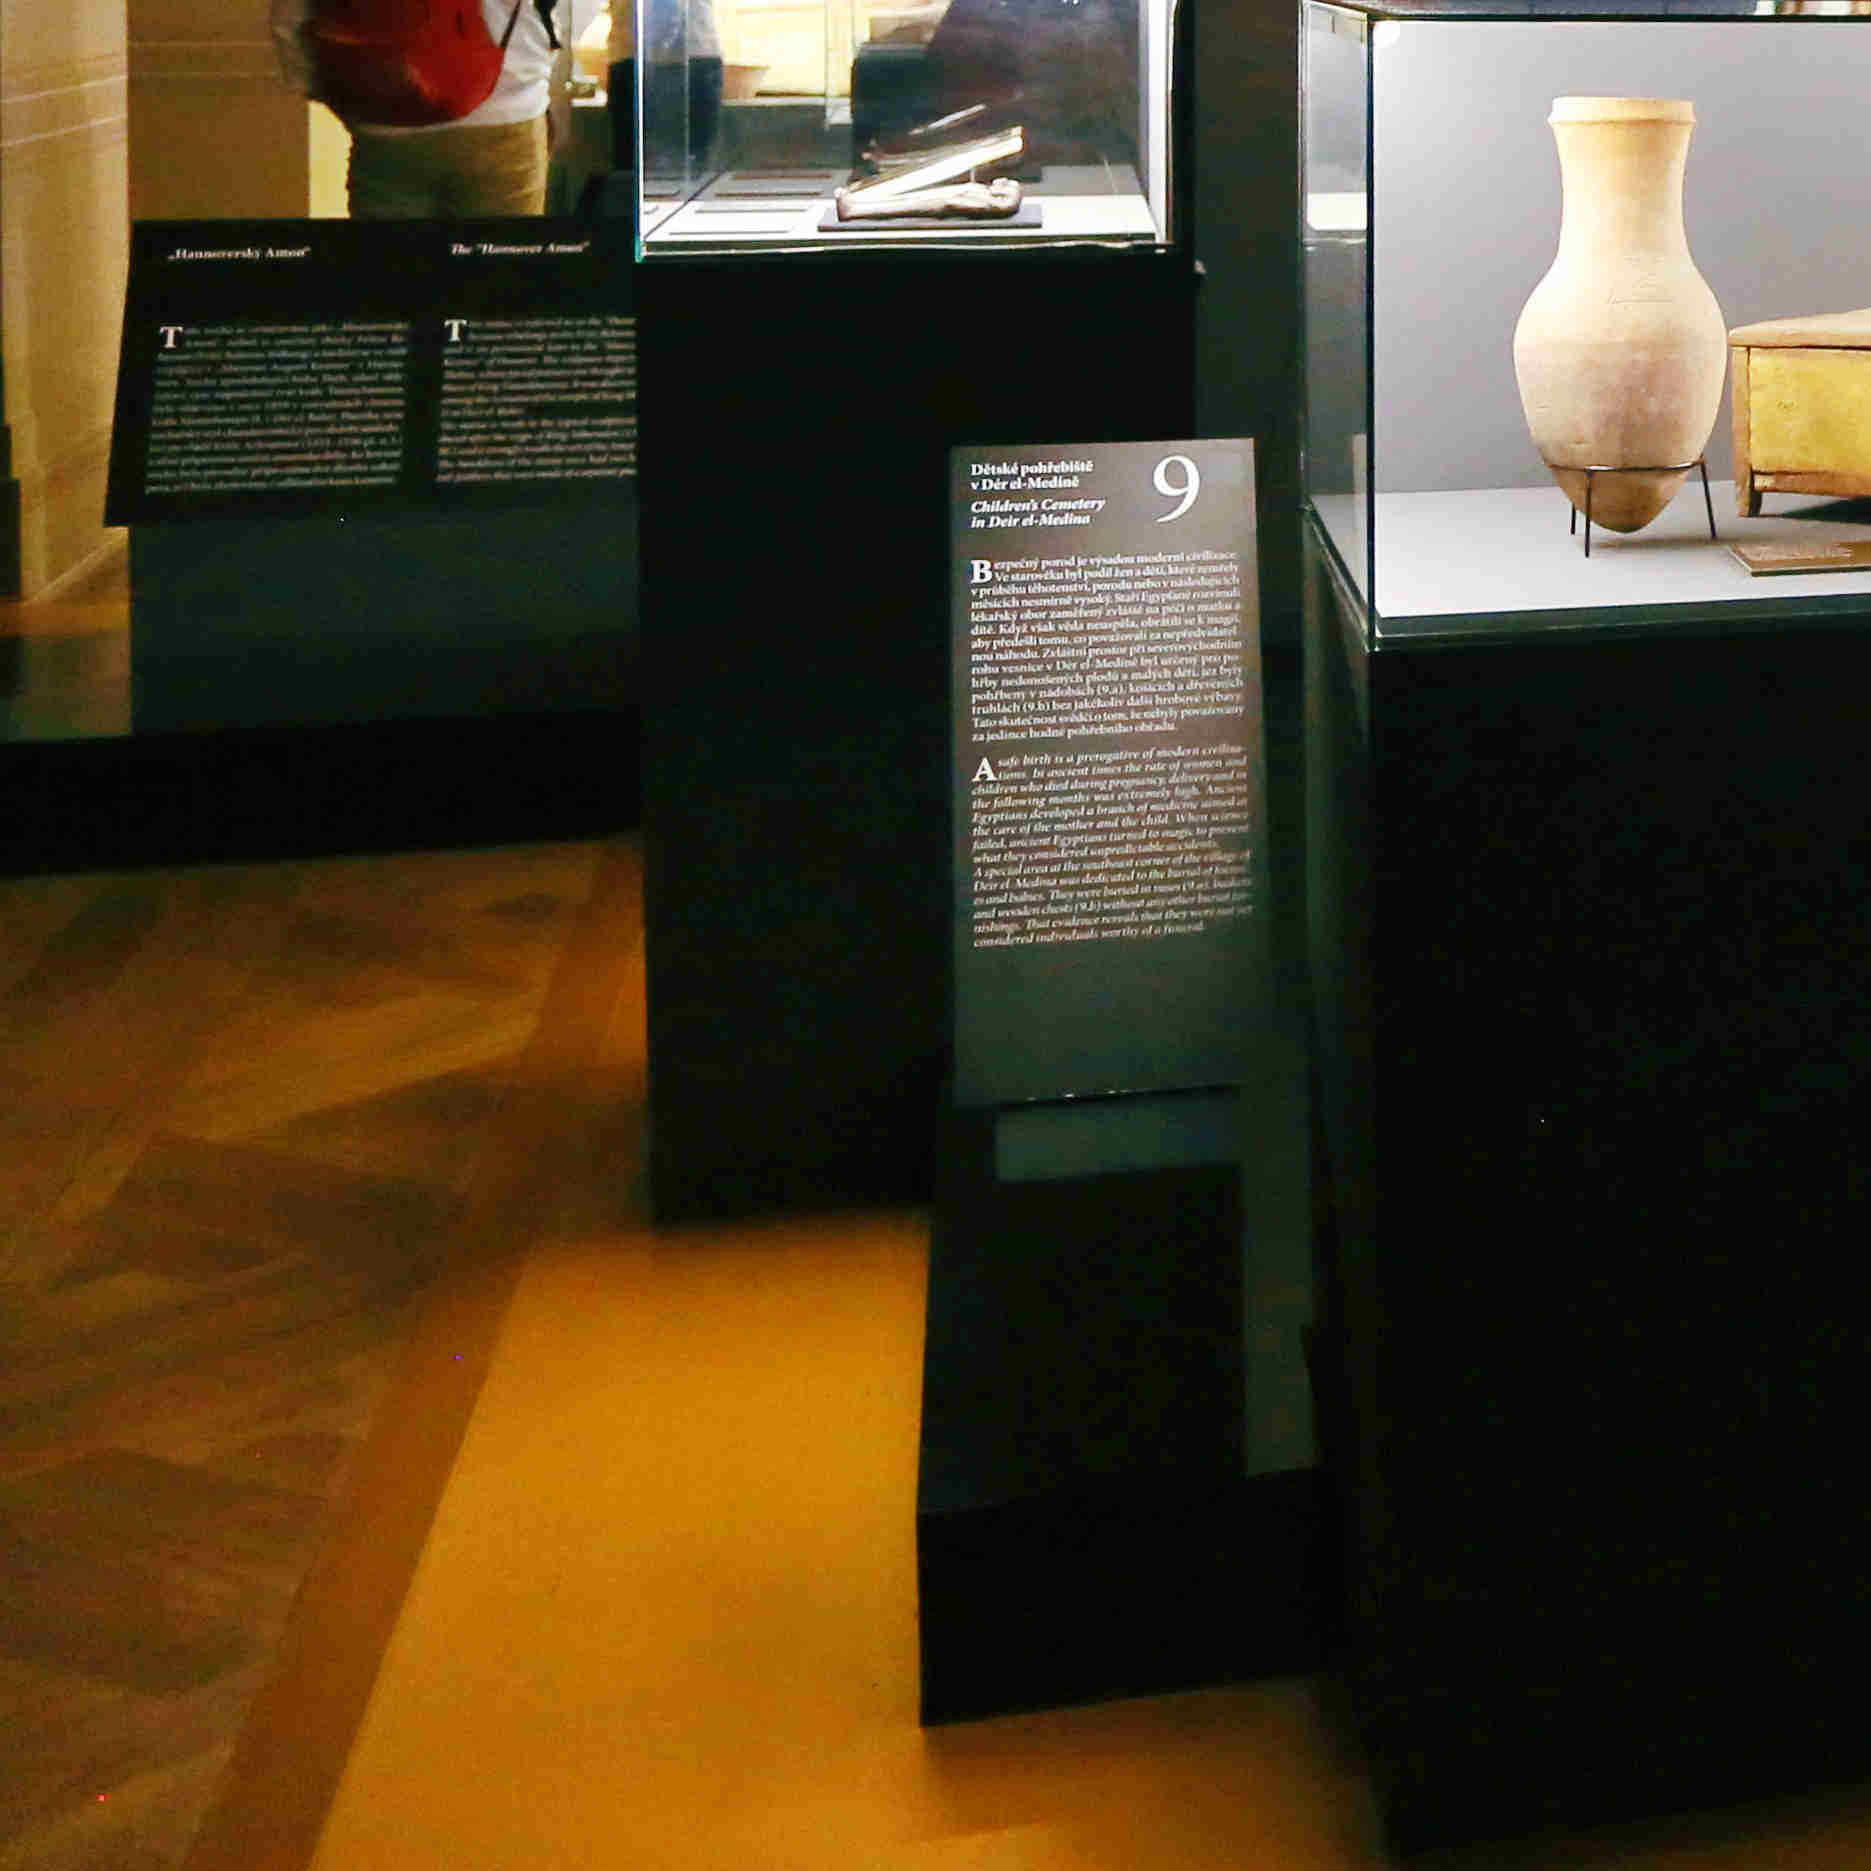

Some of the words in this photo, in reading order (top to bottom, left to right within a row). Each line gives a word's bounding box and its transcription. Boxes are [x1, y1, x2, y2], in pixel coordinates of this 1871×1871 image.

[971, 462, 1018, 476] Dětské
[1020, 460, 1094, 478] pohřebiště
[971, 481, 980, 491] v
[1152, 454, 1201, 524] 9
[1041, 497, 1106, 514] Cemetery
[971, 516, 985, 529] in
[988, 514, 1018, 529] Deir
[1020, 512, 1091, 528] el-Medina
